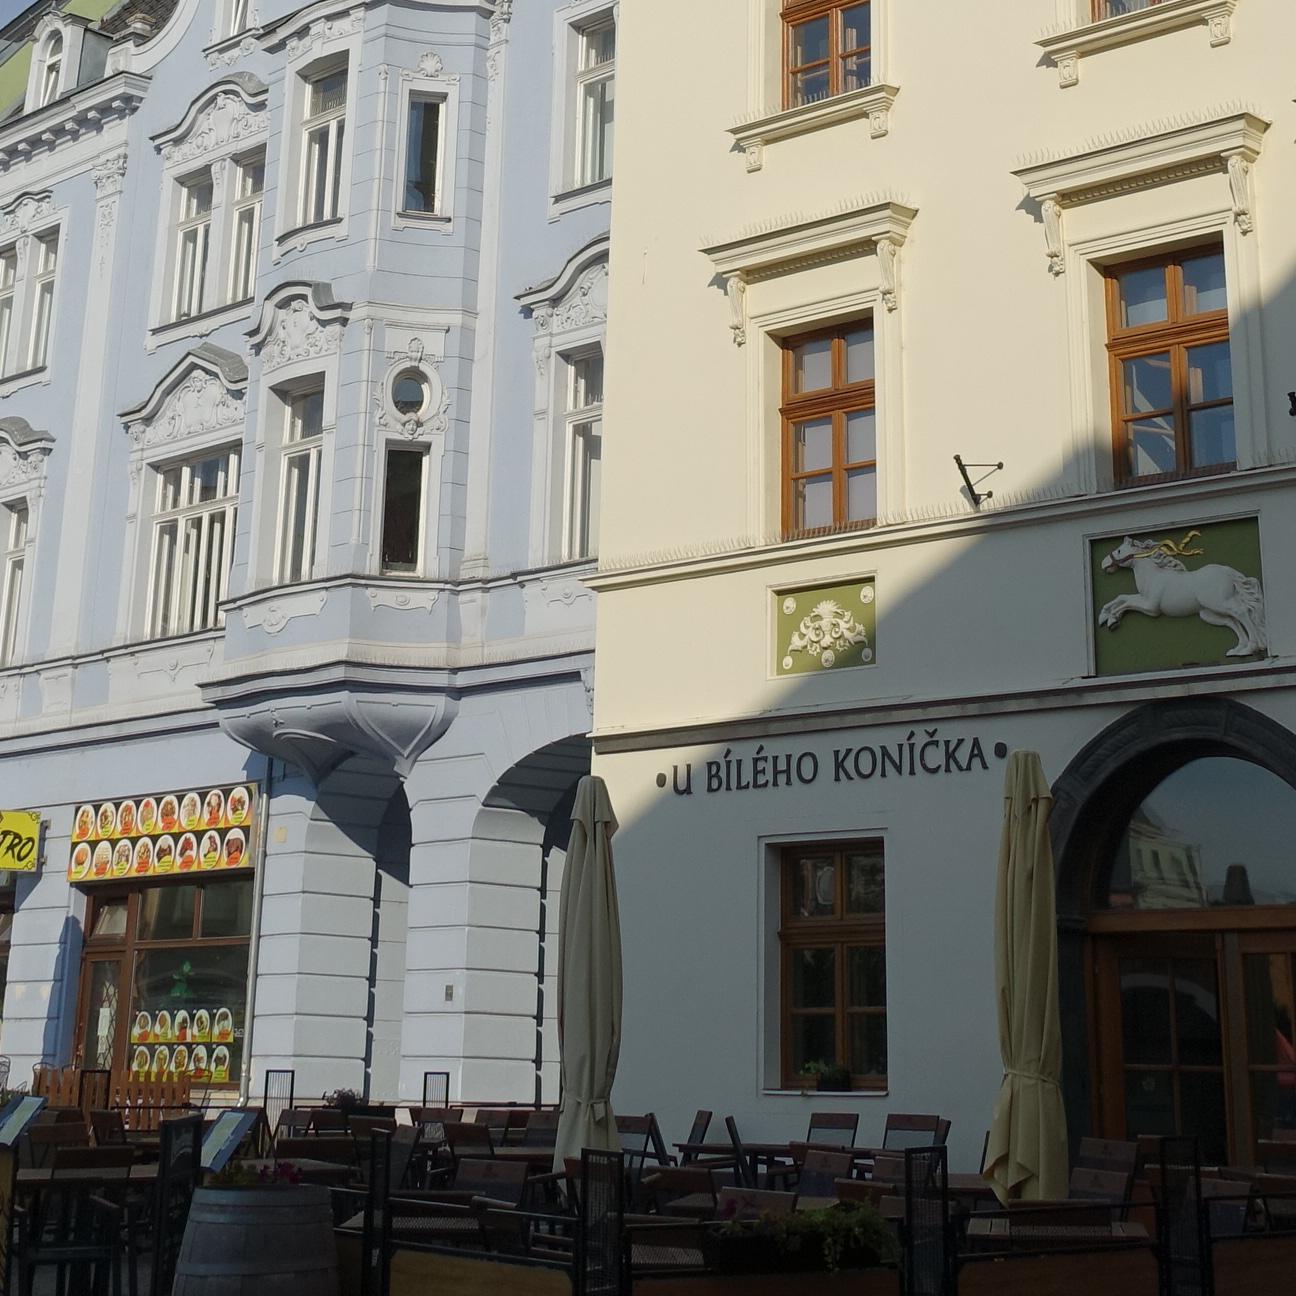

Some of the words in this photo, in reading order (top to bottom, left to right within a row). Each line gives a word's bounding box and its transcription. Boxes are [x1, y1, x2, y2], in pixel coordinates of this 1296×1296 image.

[672, 763, 693, 796] U
[705, 744, 819, 793] BÍLÉHO
[833, 728, 990, 783] KONÍČKA
